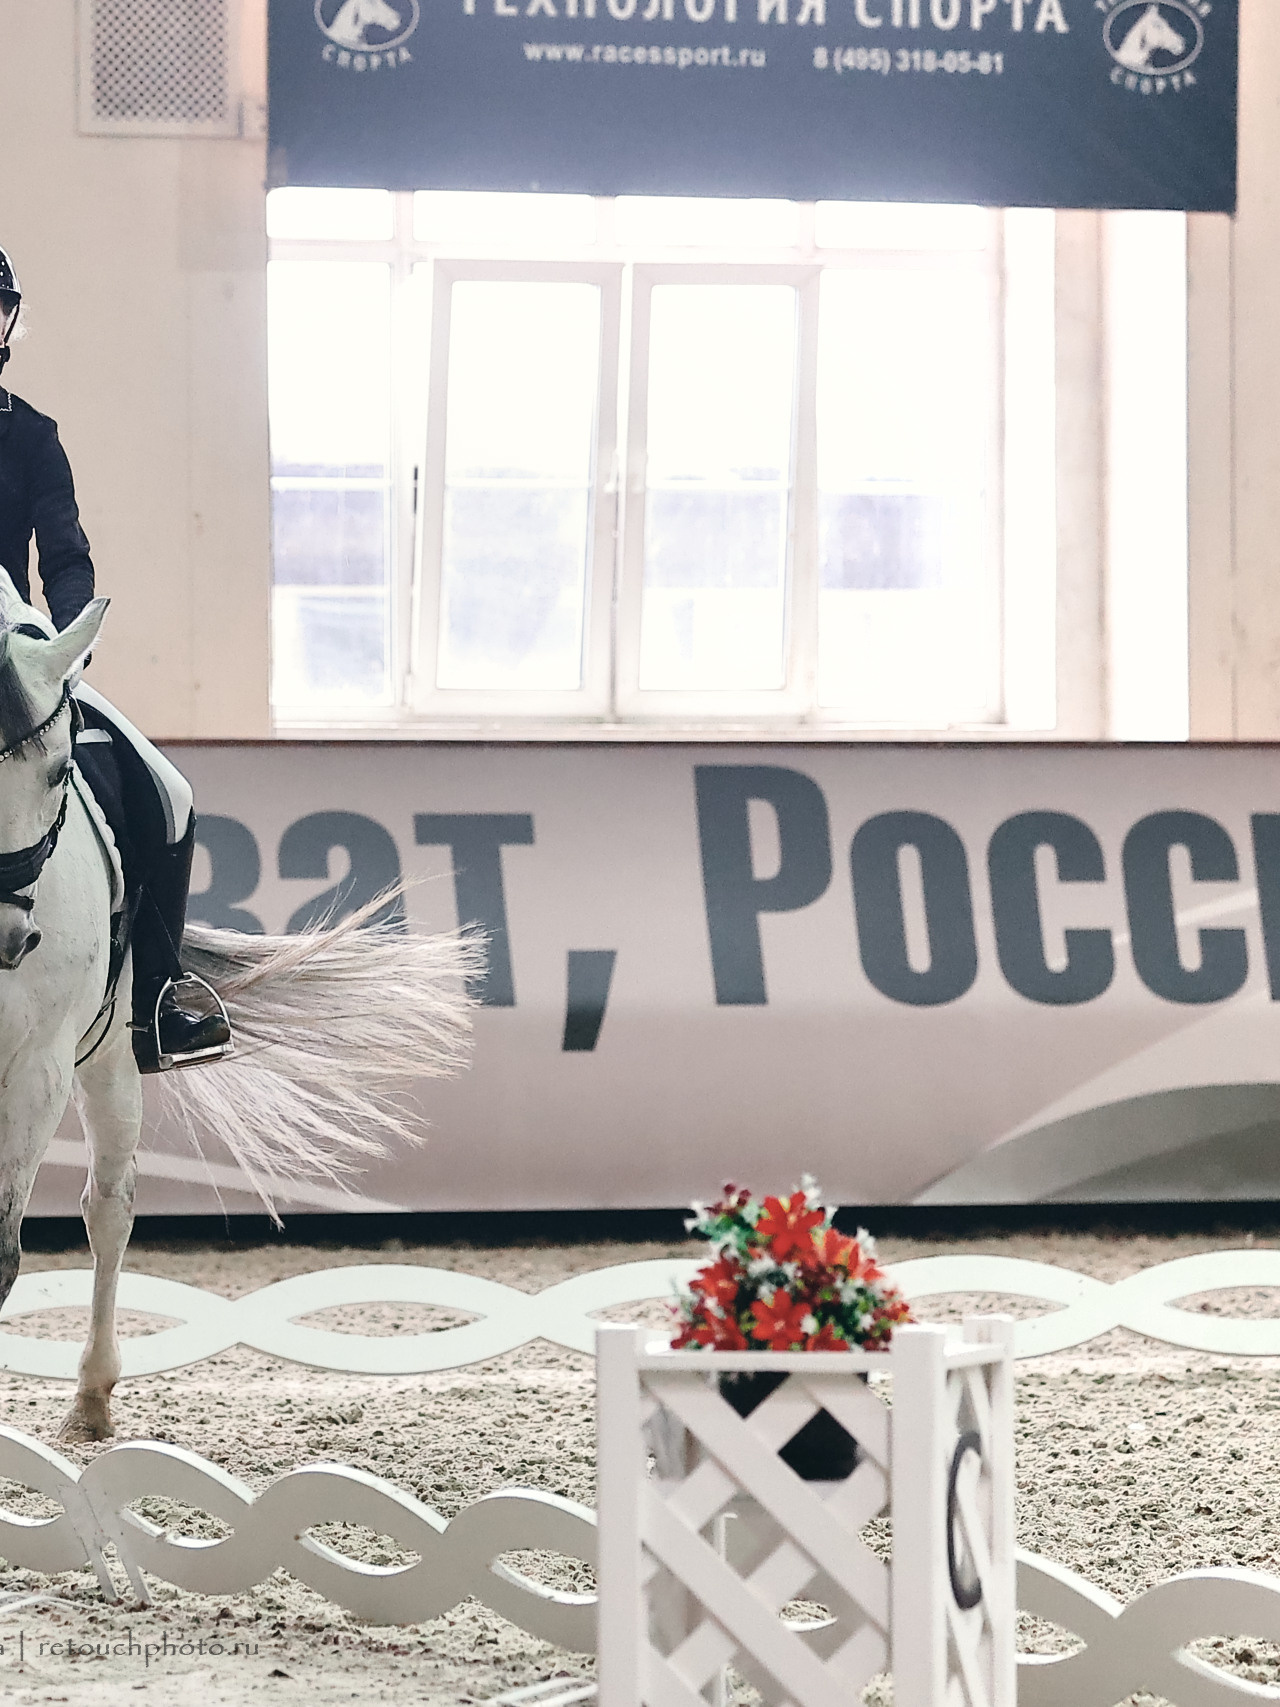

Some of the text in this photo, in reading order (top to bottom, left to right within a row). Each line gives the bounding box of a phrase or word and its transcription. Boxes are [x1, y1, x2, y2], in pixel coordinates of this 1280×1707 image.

[854, 0, 1070, 33] СПОРТА
[522, 42, 767, 69] www.racessport.ru
[813, 46, 829, 69] 8
[694, 764, 1280, 1007] Росс
